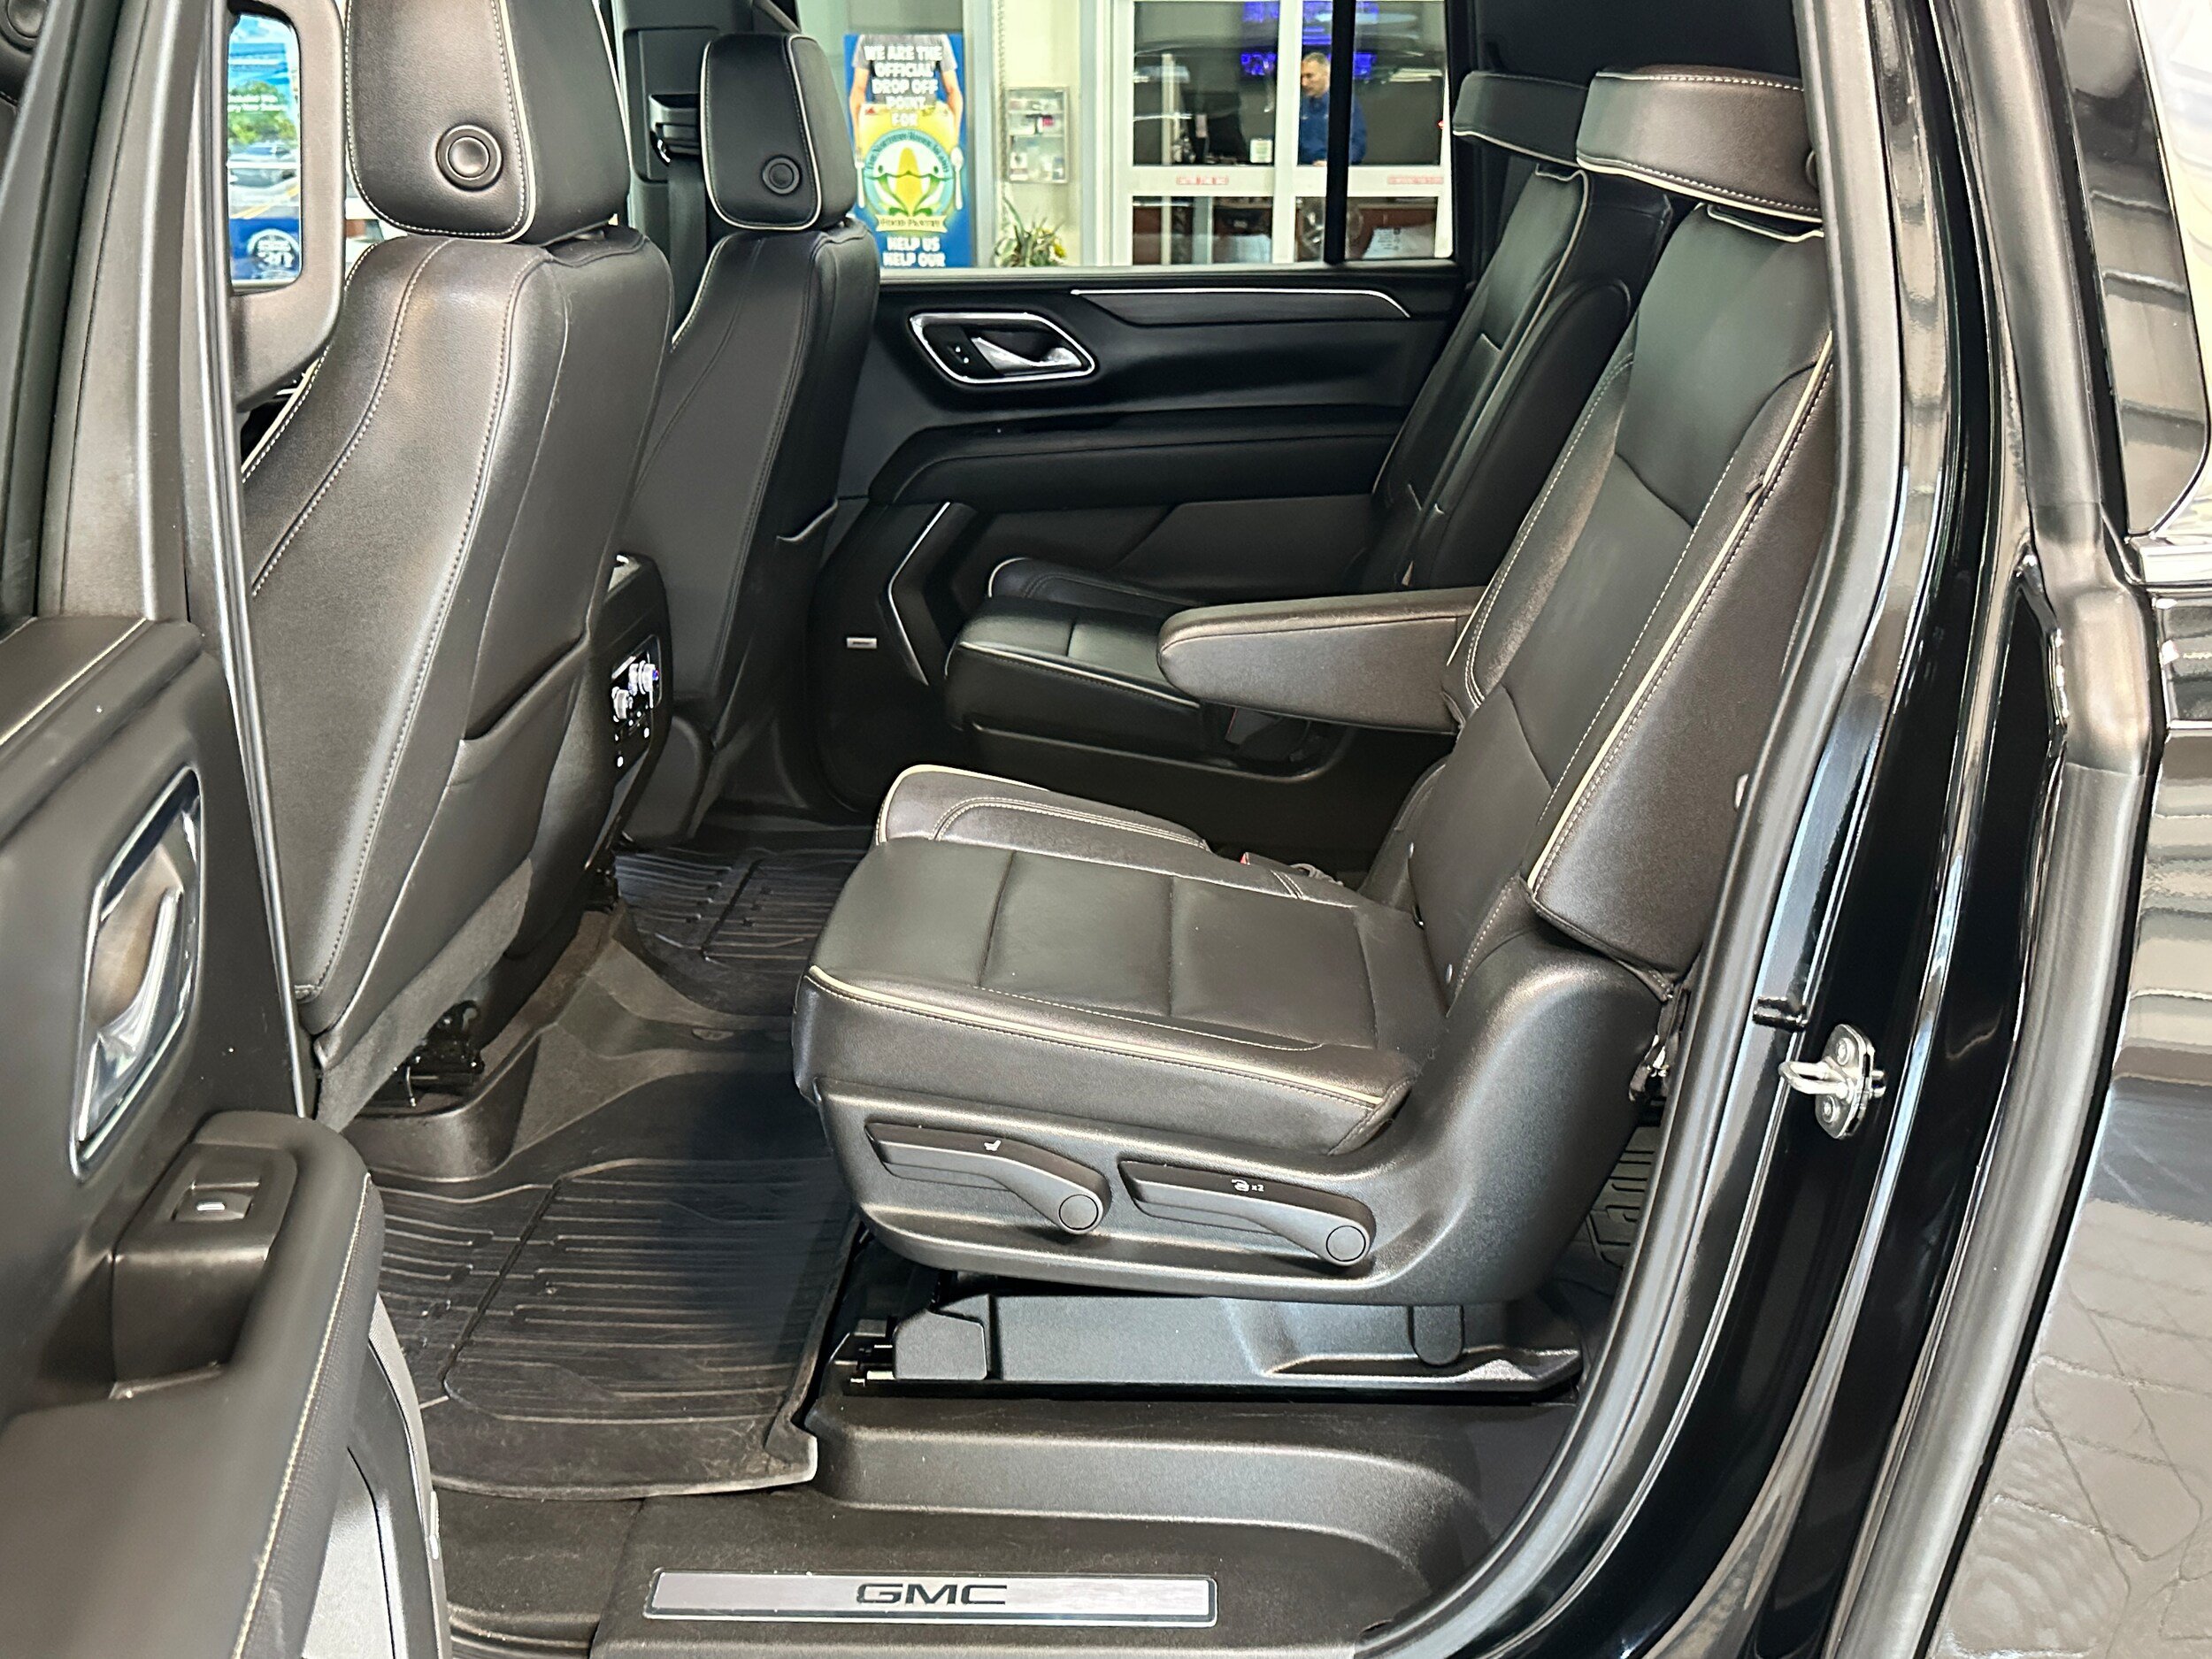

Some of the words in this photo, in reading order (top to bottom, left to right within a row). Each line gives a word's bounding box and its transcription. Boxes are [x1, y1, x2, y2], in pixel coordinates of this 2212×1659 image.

[864, 45, 886, 60] WE
[887, 45, 915, 60] ARE
[916, 45, 942, 60] THE
[874, 62, 933, 77] OFFICIAL
[872, 79, 910, 94] DROP
[911, 79, 938, 94] OFF
[886, 96, 926, 110] POINT
[891, 112, 918, 127] FOR
[887, 236, 920, 251] HELP
[921, 237, 941, 252] US
[882, 251, 917, 266] HELP
[918, 252, 946, 267] OUR
[856, 1584, 1007, 1604] GMC
